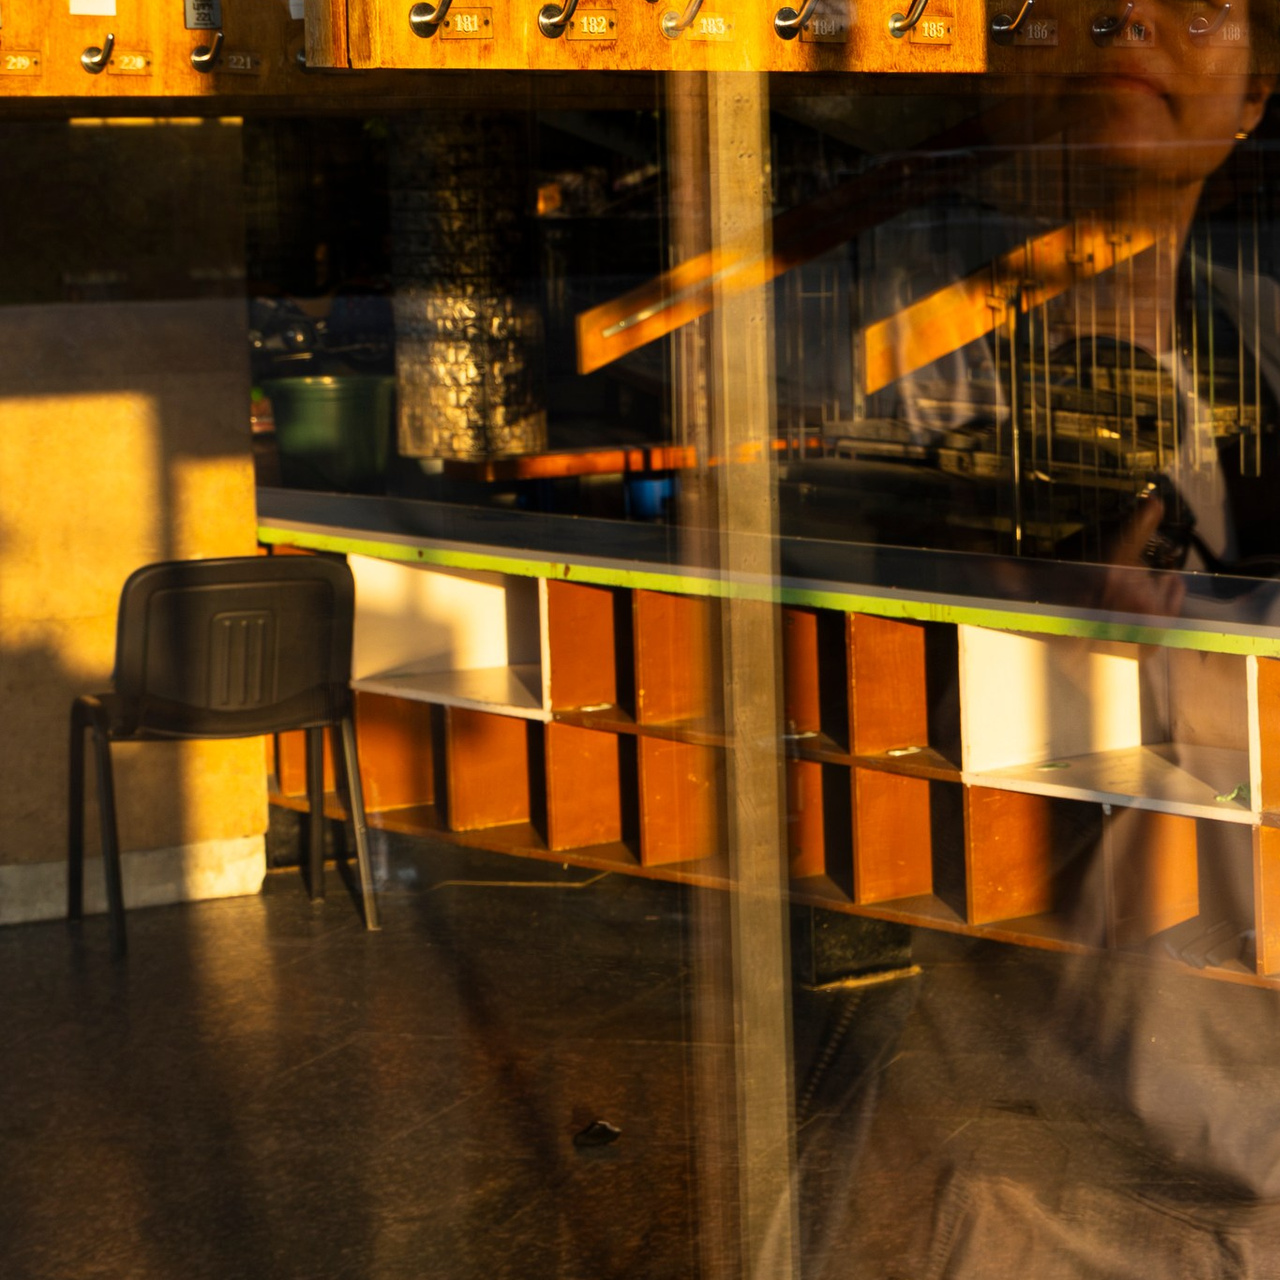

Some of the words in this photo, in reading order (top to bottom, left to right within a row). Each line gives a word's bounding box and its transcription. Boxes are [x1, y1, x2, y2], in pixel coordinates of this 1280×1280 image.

[455, 14, 480, 34] 181
[581, 16, 607, 35] 182
[700, 17, 724, 34] 183
[813, 19, 836, 37] 184
[922, 22, 945, 39] 185
[1027, 23, 1047, 41] 186
[1127, 24, 1146, 41] 187
[1222, 24, 1241, 41] 188
[228, 55, 252, 70] 221
